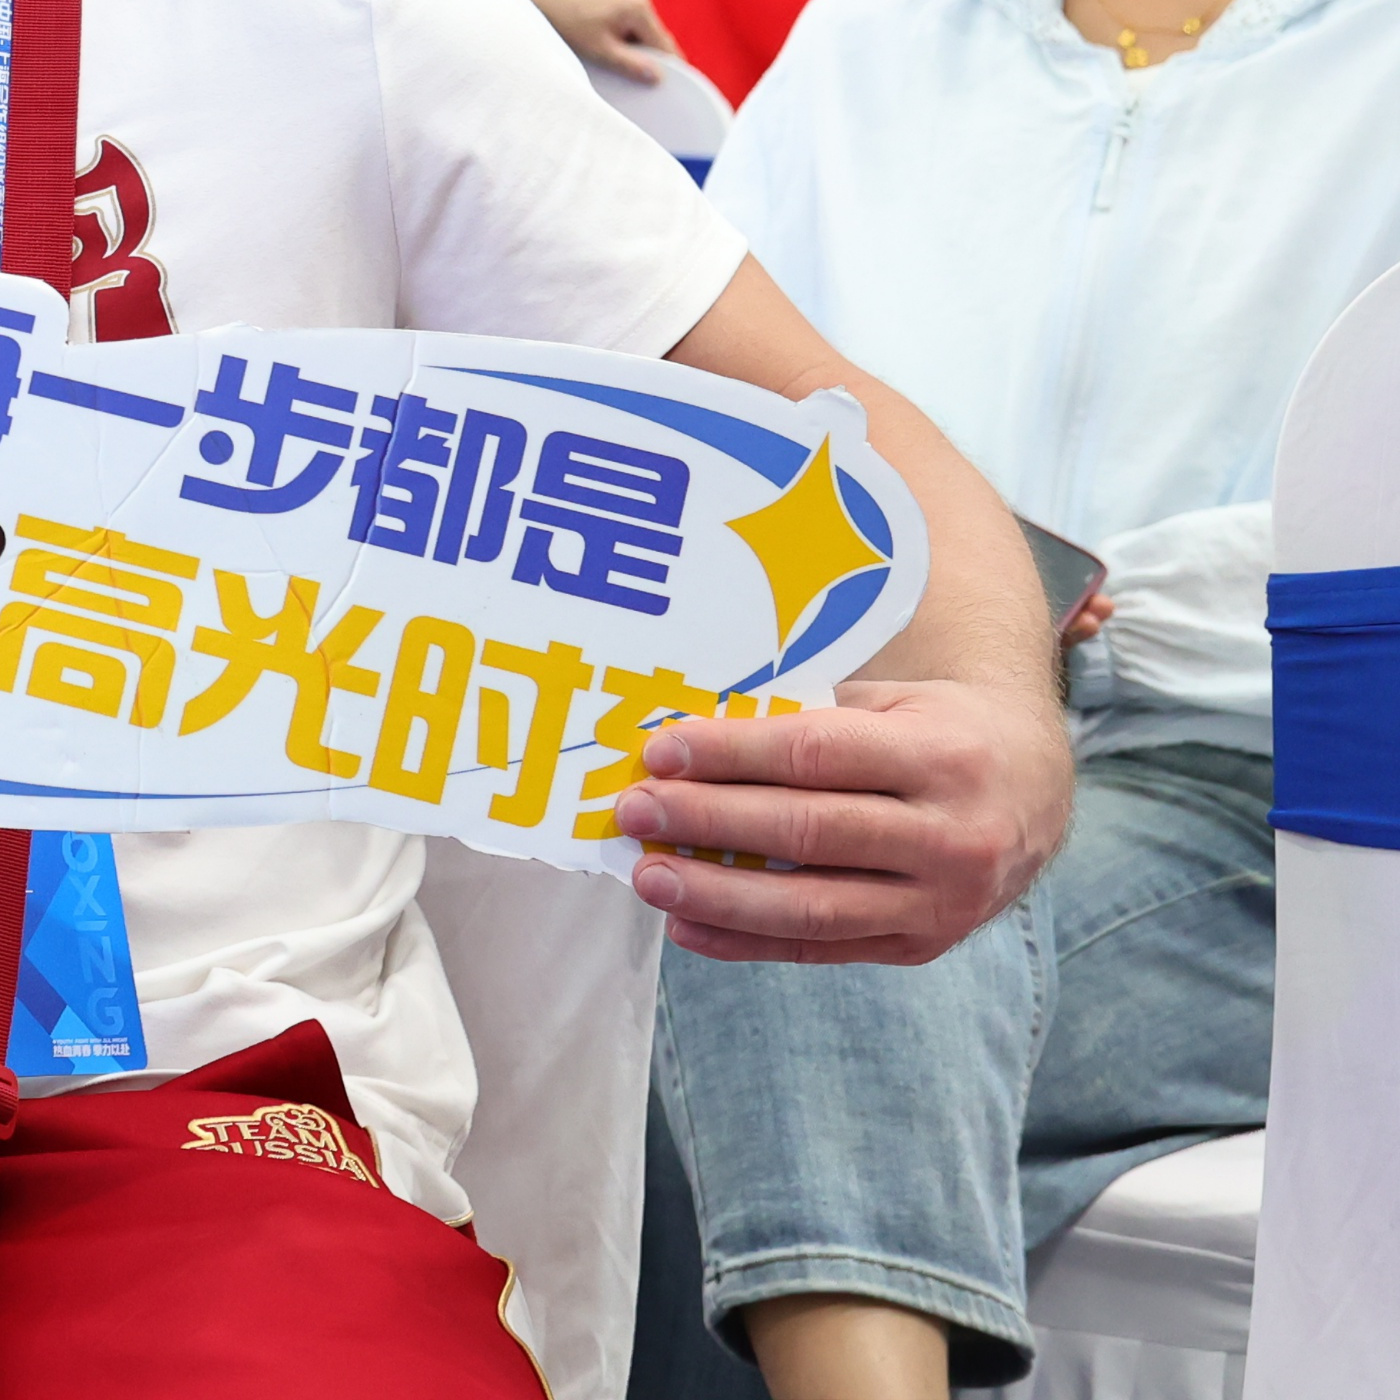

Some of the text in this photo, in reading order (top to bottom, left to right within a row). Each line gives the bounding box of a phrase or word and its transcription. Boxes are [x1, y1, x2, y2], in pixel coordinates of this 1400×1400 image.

[62, 831, 125, 1036] OXING
[205, 1121, 338, 1152] TEAM
[196, 1141, 367, 1182] USSIA
